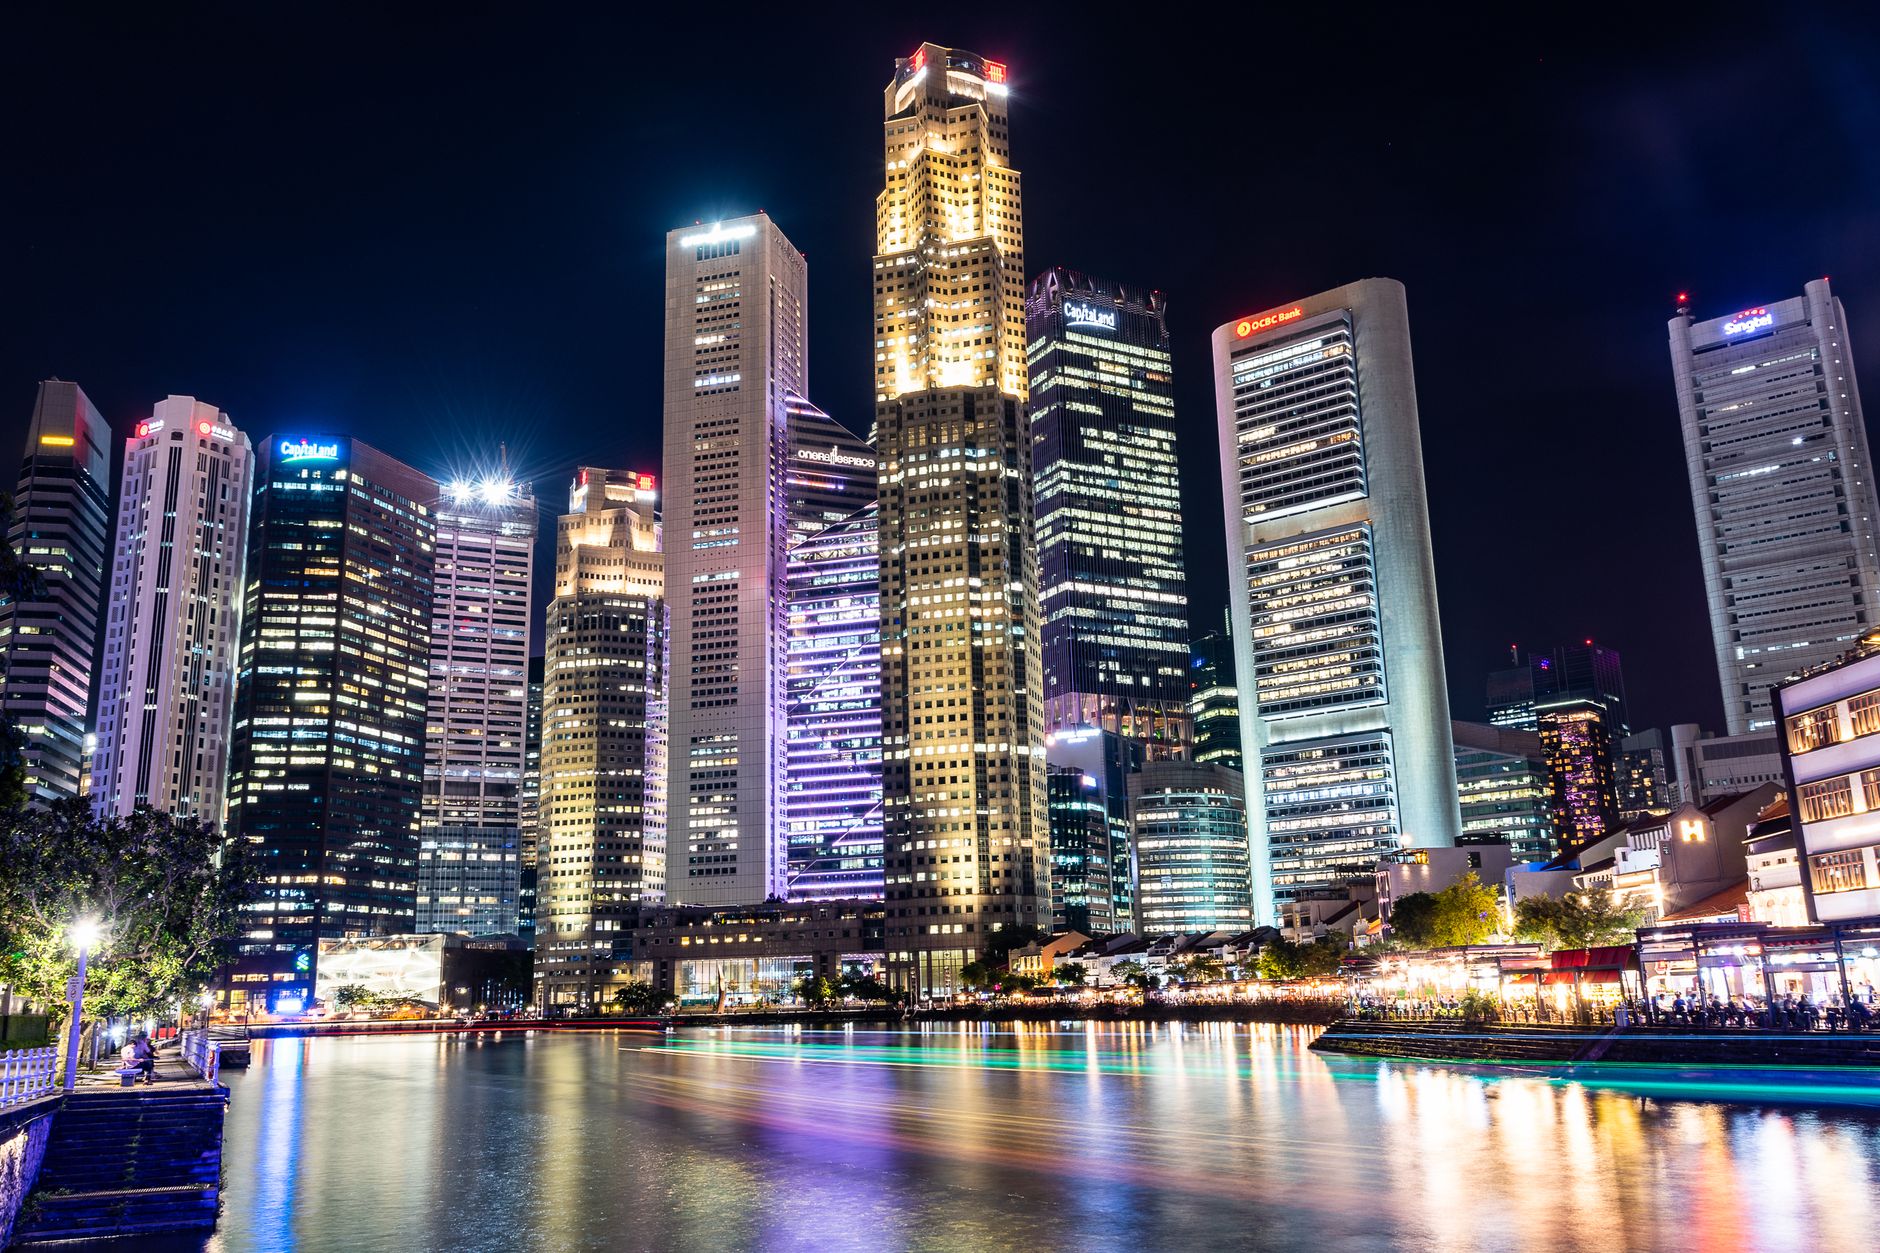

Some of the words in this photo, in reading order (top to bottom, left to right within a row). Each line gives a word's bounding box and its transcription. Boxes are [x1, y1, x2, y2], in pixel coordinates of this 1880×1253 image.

[1064, 302, 1115, 326] CapitaLand
[1252, 315, 1277, 330] OCBC
[1279, 308, 1301, 322] Bank
[280, 438, 338, 458] CapitaLand
